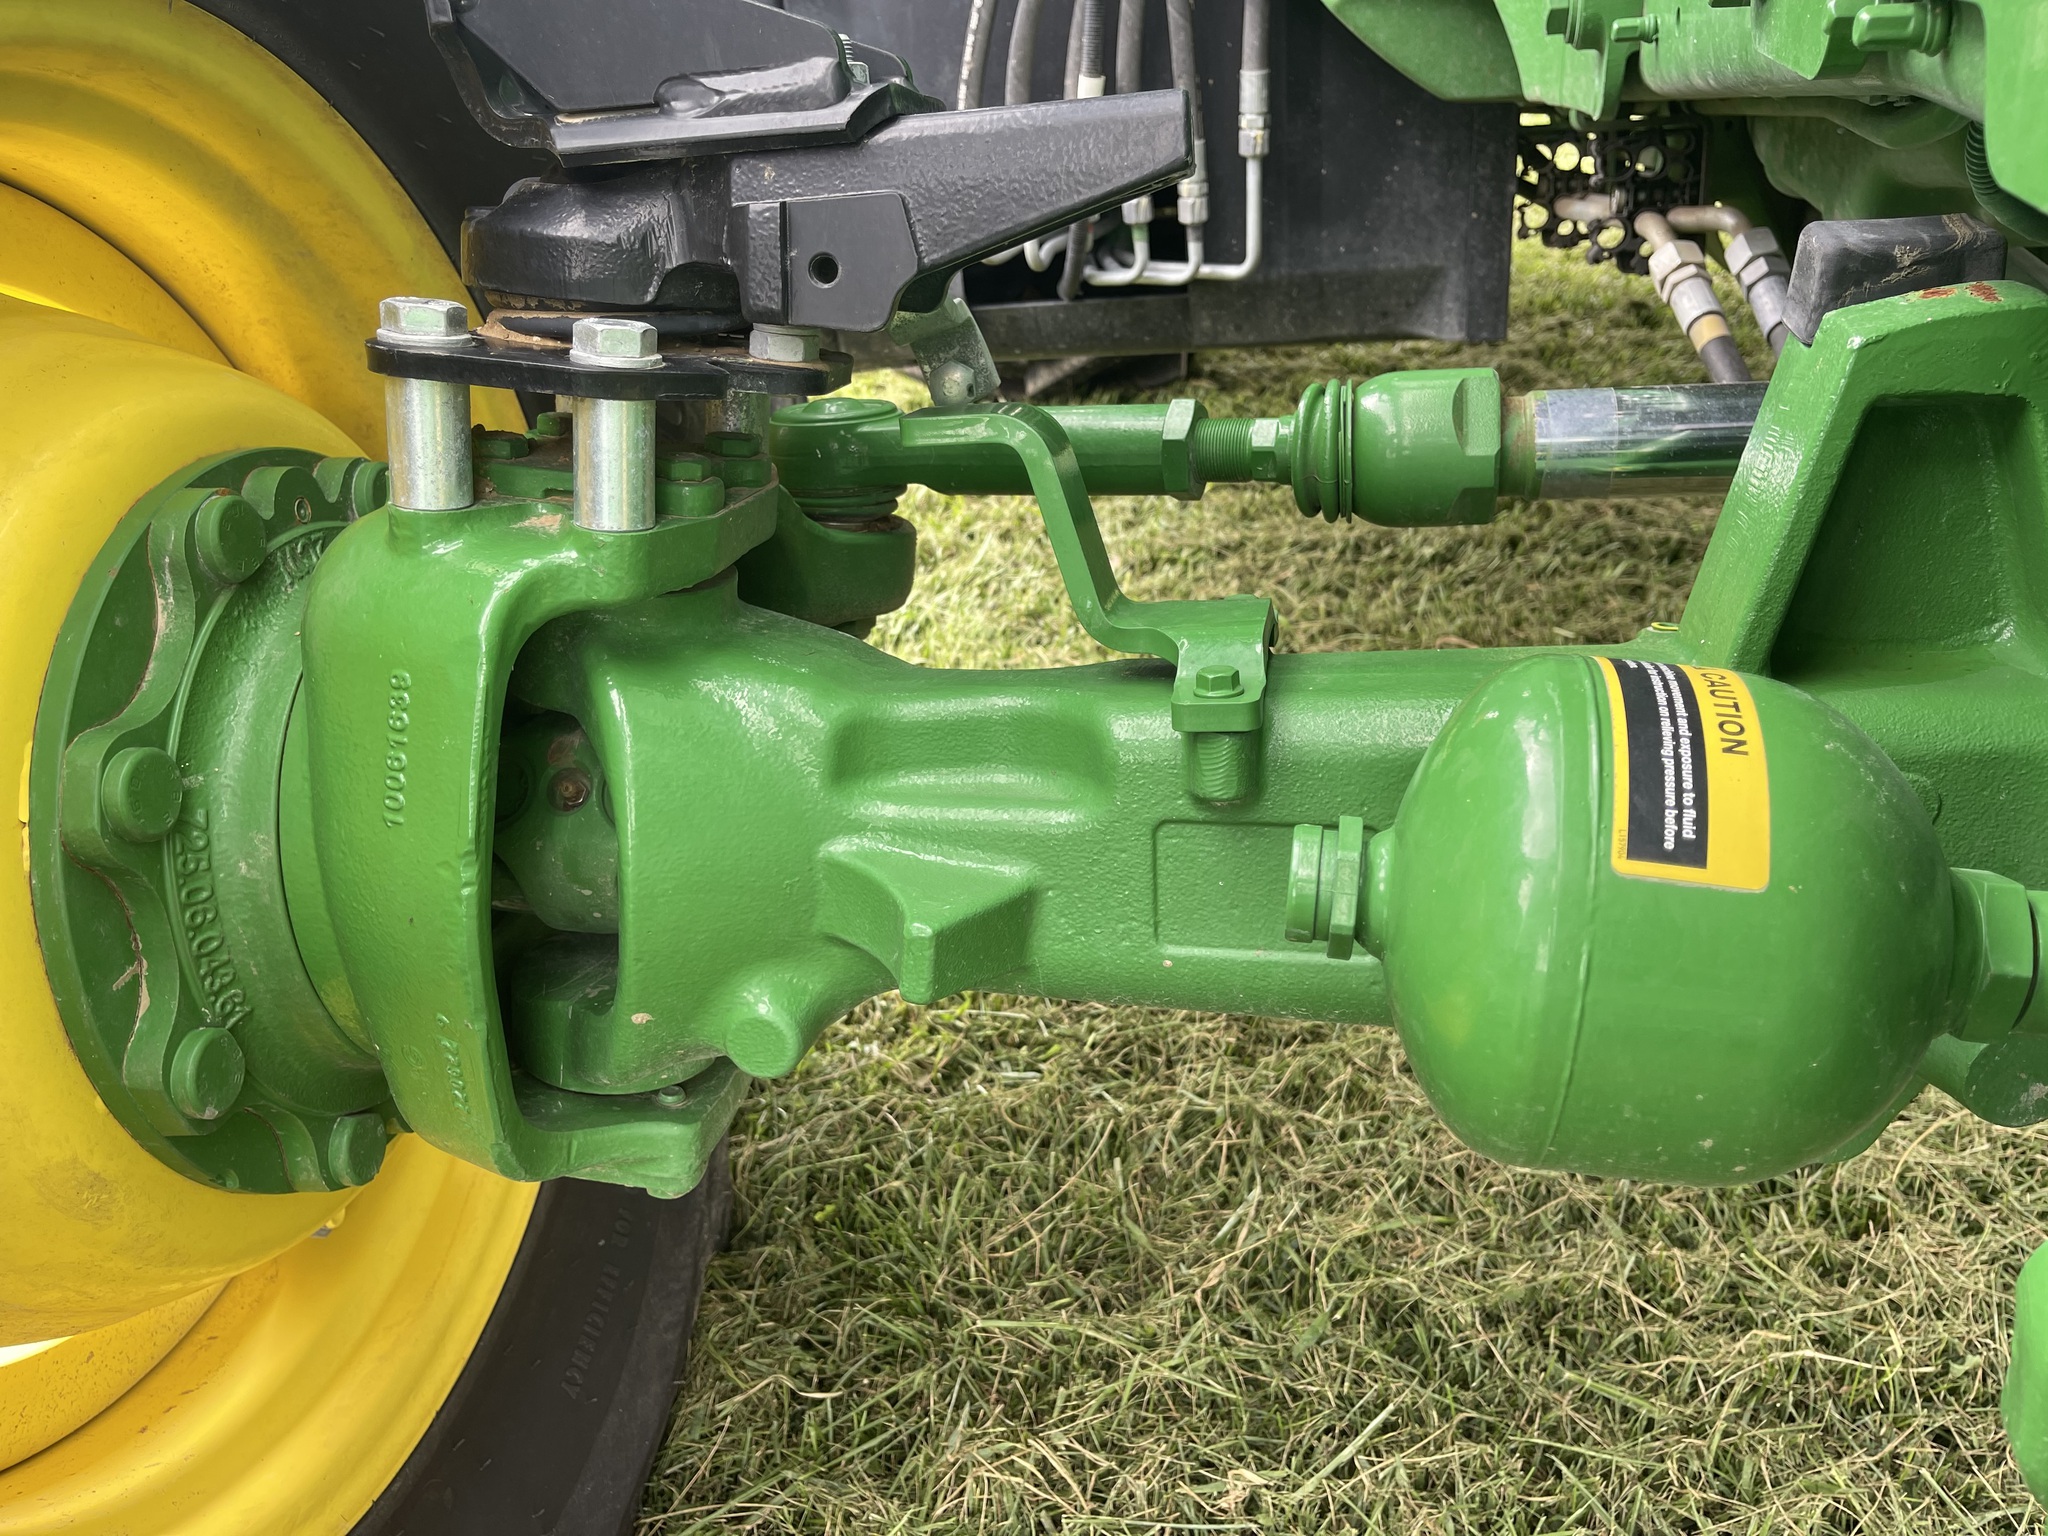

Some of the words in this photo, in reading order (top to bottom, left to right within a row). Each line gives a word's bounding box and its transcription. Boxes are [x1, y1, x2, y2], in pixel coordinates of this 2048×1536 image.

[1650, 675, 1669, 705] instruction
[1668, 680, 1688, 717] movement
[1658, 706, 1669, 718] on
[1677, 717, 1692, 737] and
[1700, 672, 1749, 756] CAUTION
[1660, 717, 1676, 756] relieving
[1661, 757, 1676, 807] pressure
[1678, 737, 1694, 790] exposure
[1682, 793, 1696, 806] to
[1663, 809, 1679, 851] before
[1682, 809, 1697, 839] fluid
[560, 1262, 621, 1400] EFFICIENCY
